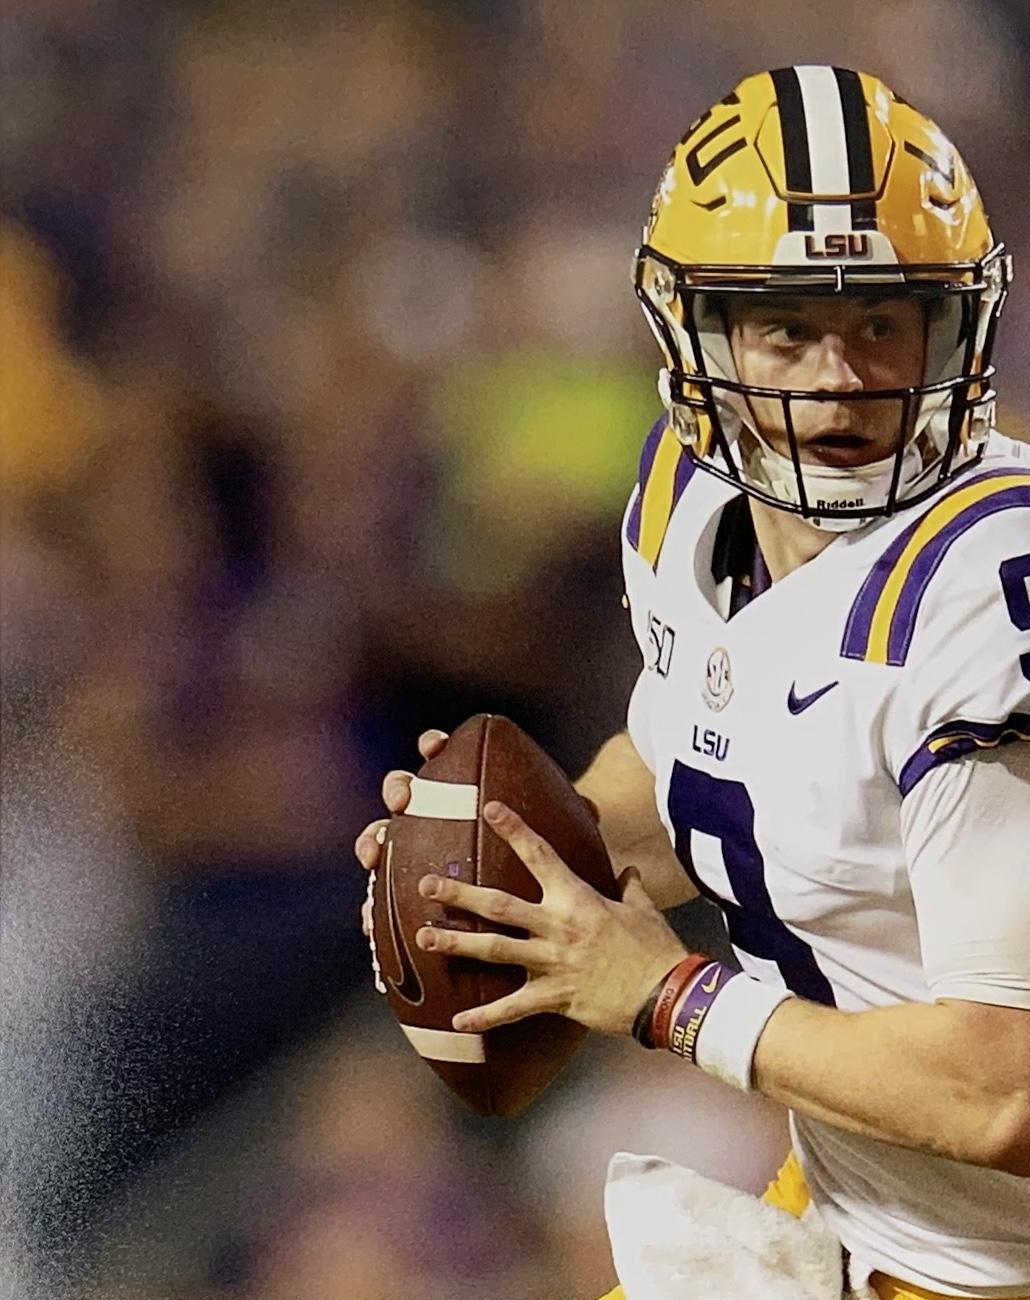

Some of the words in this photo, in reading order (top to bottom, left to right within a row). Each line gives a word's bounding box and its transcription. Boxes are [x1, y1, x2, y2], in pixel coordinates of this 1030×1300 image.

[804, 234, 871, 260] LSU
[817, 498, 864, 510] Riddell
[693, 725, 730, 761] LSU
